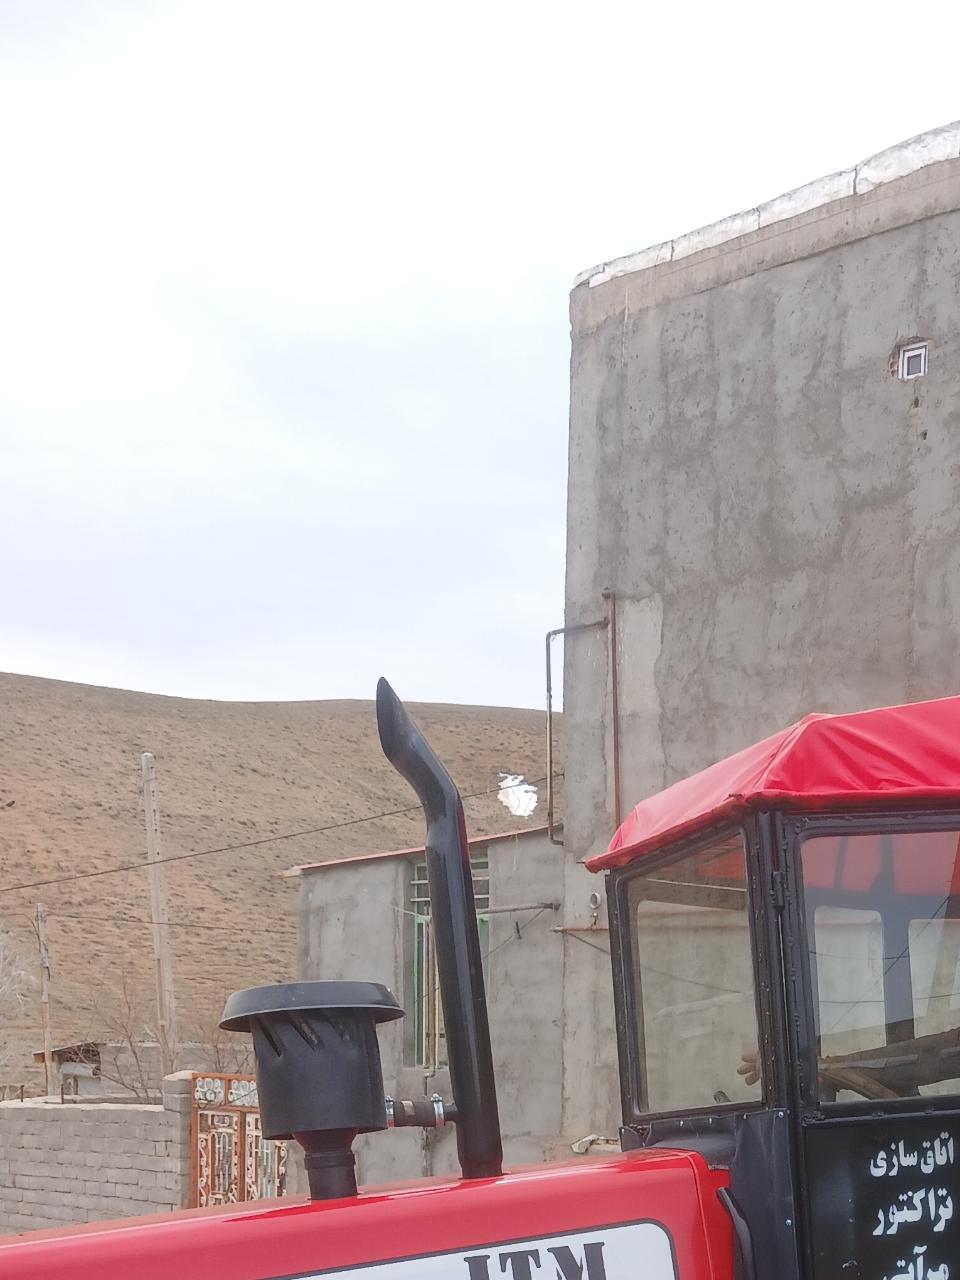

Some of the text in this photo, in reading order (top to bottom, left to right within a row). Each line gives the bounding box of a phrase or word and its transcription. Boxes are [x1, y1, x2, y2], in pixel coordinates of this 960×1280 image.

[870, 1131, 954, 1177] اتاق سازی
[872, 1187, 953, 1236] تراکتور
